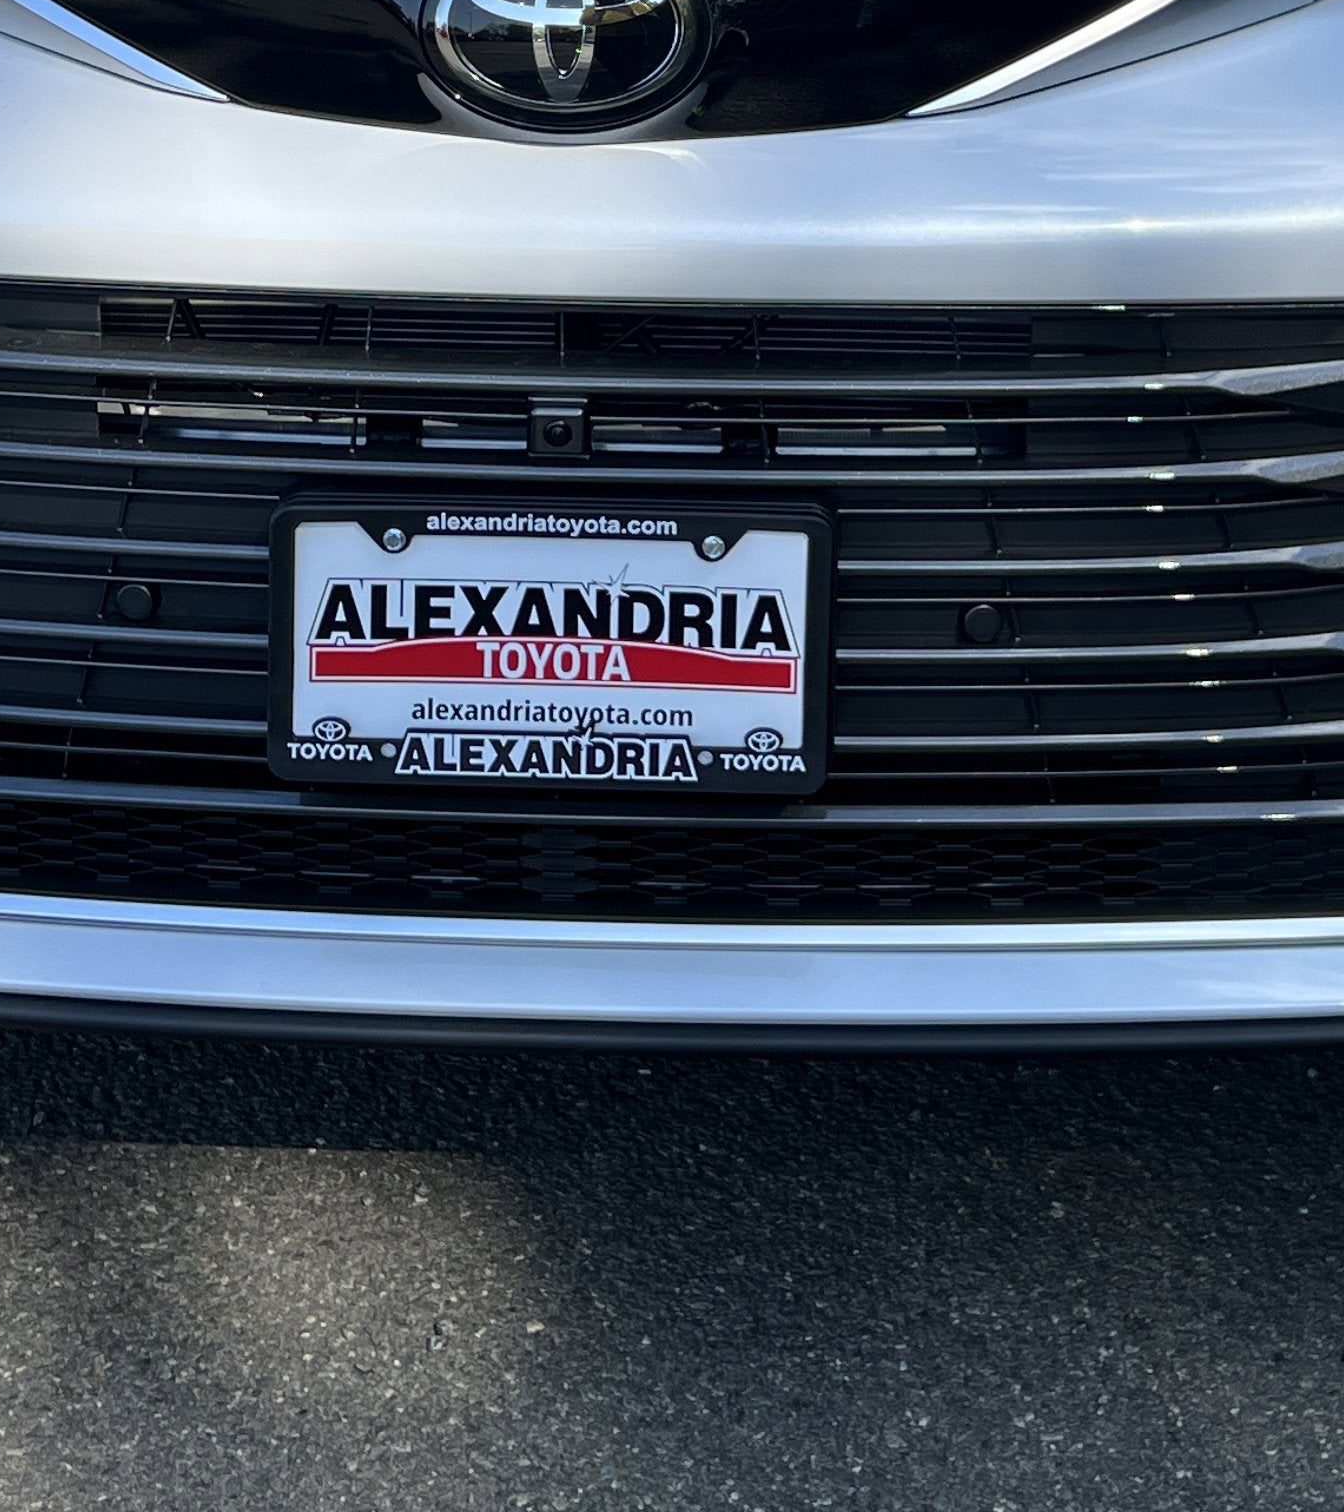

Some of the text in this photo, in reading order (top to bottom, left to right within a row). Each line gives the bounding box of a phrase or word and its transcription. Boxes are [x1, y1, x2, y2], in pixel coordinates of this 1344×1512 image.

[426, 511, 678, 537] alexandriatoyota.com
[312, 580, 794, 652] ALEXANDRIA
[475, 641, 632, 682] TOYOTA
[411, 697, 694, 729] alexandriatoyota.com
[286, 732, 807, 782] TOYOTA ALEXANDRIA TOYOTA
